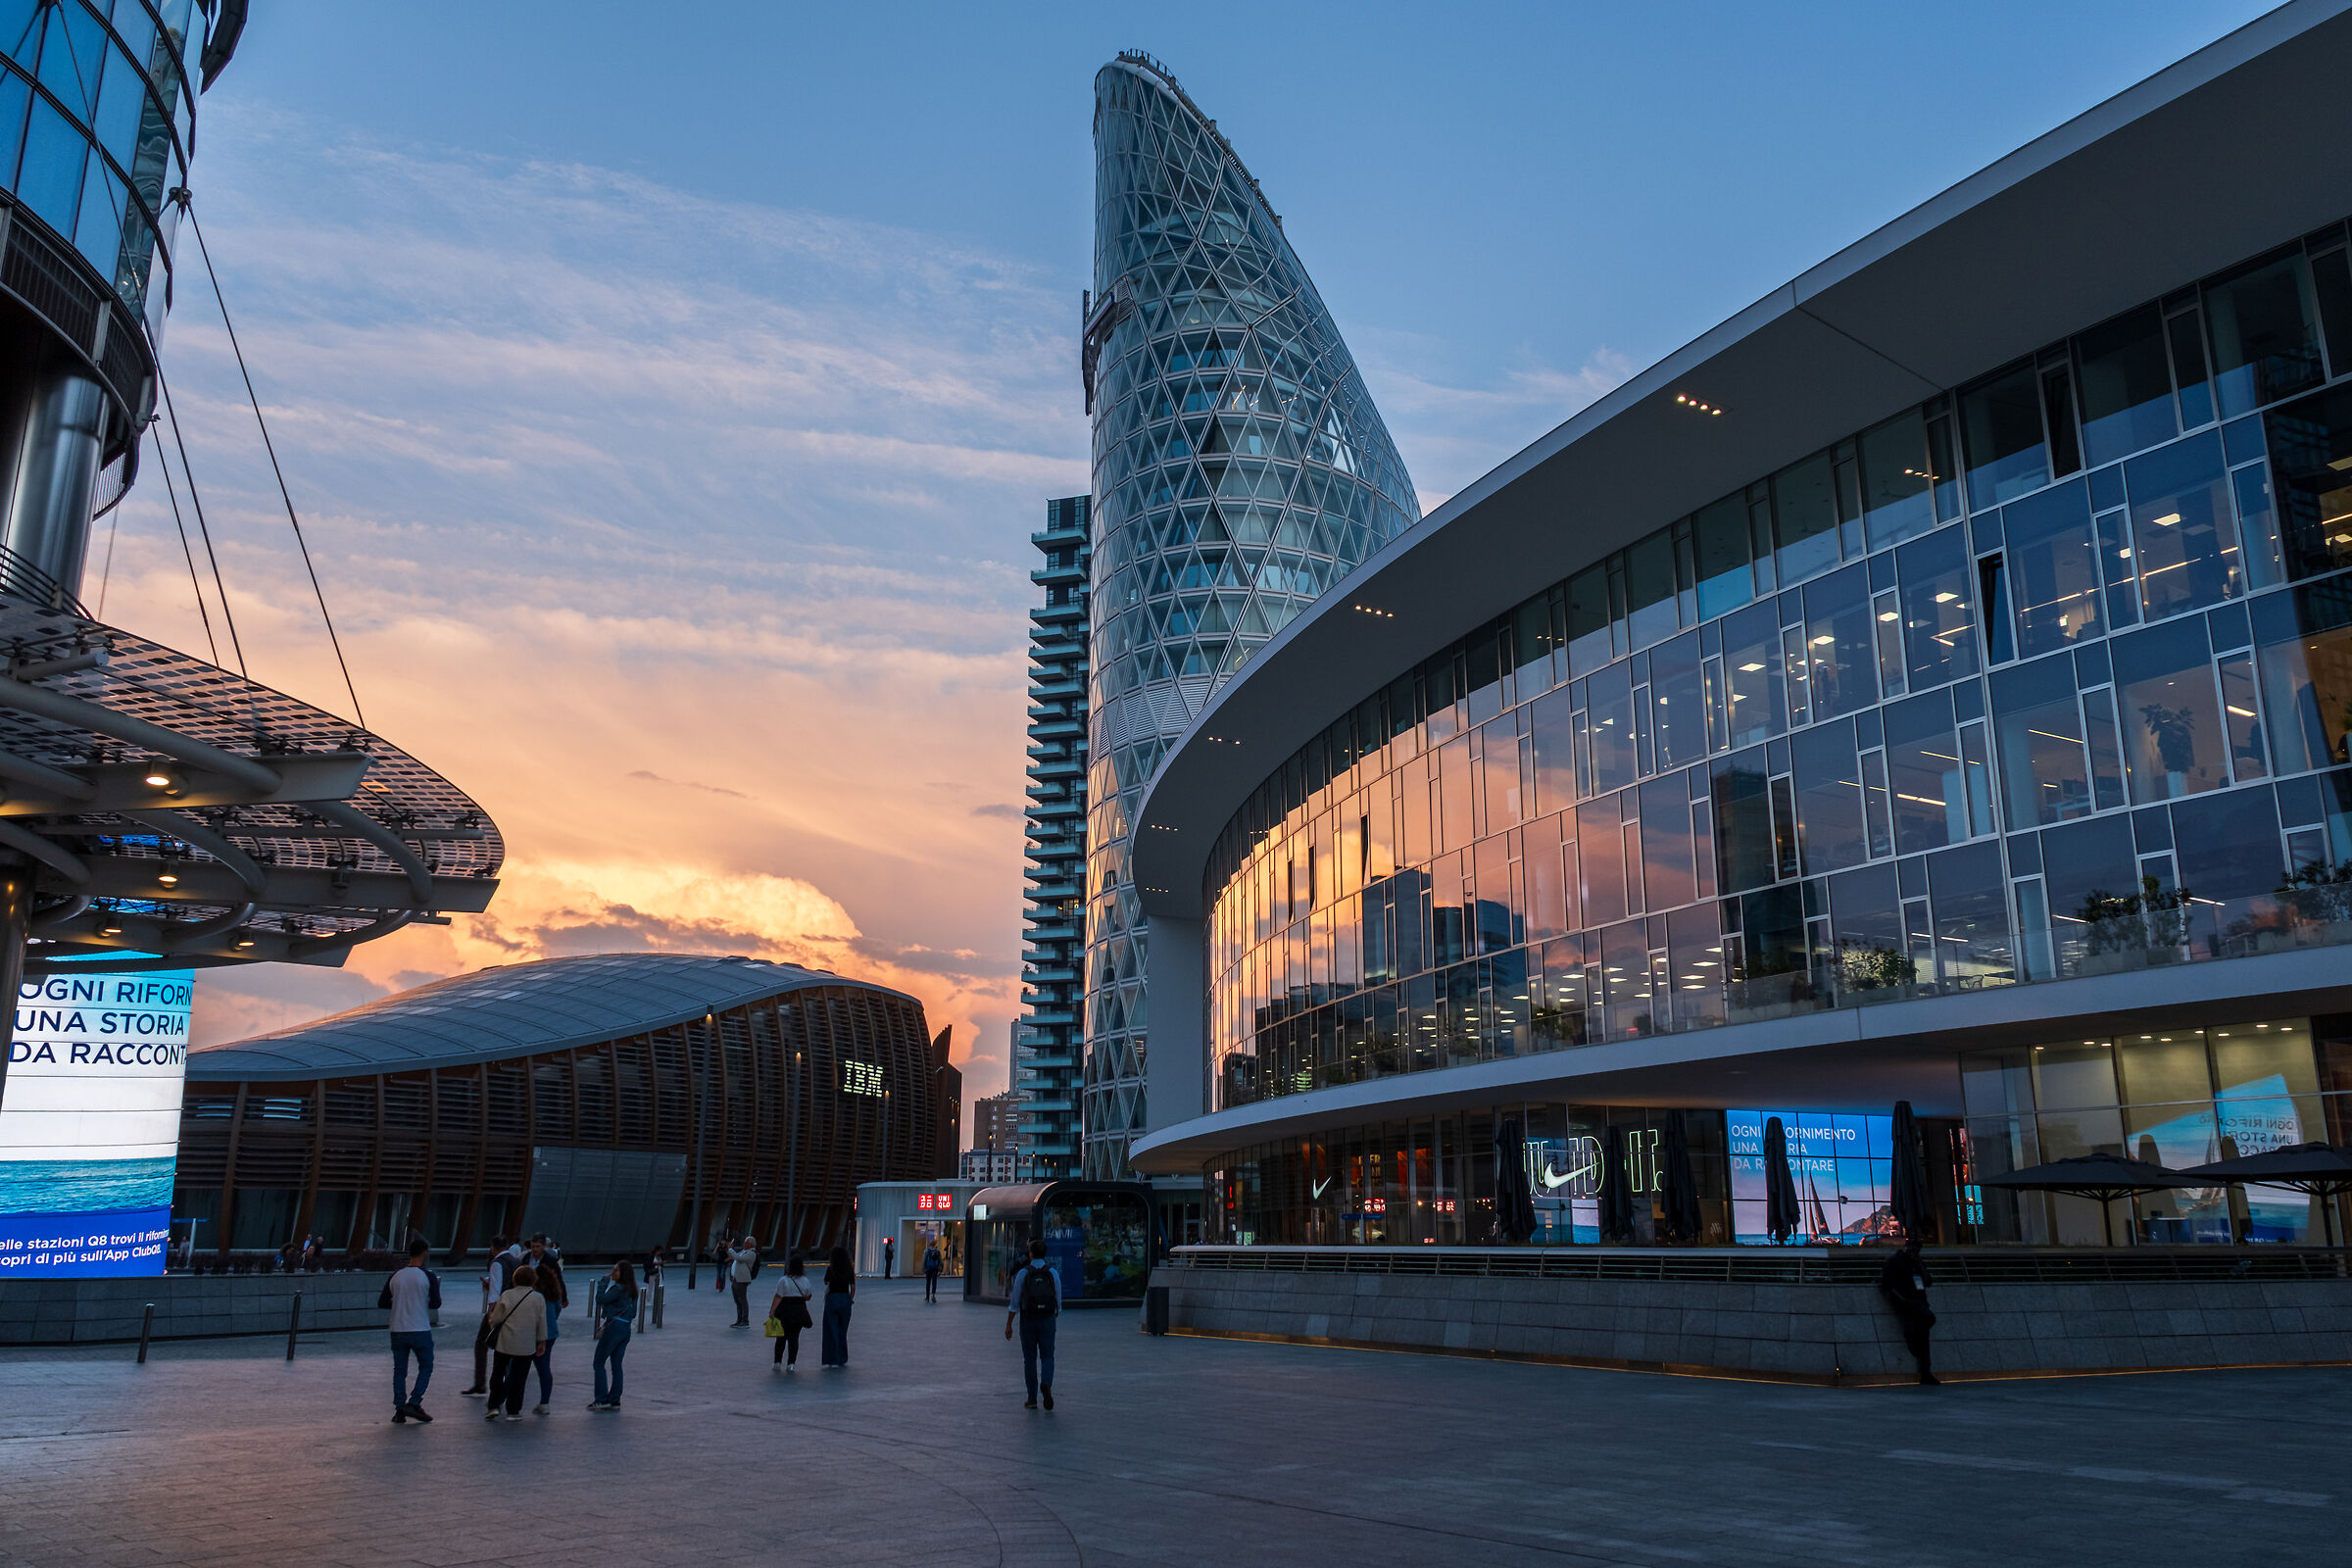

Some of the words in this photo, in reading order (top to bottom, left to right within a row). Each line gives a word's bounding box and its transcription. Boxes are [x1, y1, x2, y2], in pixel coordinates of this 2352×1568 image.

[19, 979, 104, 1001] OGNI
[14, 1010, 87, 1032] UNA
[100, 1012, 184, 1035] STORIA
[9, 1042, 57, 1063] DA
[71, 1043, 187, 1065] RACCONT
[844, 1060, 883, 1097] IBM
[1732, 1125, 1761, 1137] OGNI
[1783, 1127, 1855, 1141] ORNIMENTO
[1733, 1142, 1759, 1153] UNA
[1734, 1157, 1751, 1169] DA
[27, 1236, 84, 1250] stazioni
[88, 1235, 108, 1247] Q8
[111, 1232, 136, 1245] trovi
[138, 1231, 144, 1243] il
[35, 1252, 49, 1264] di
[53, 1251, 77, 1266] più
